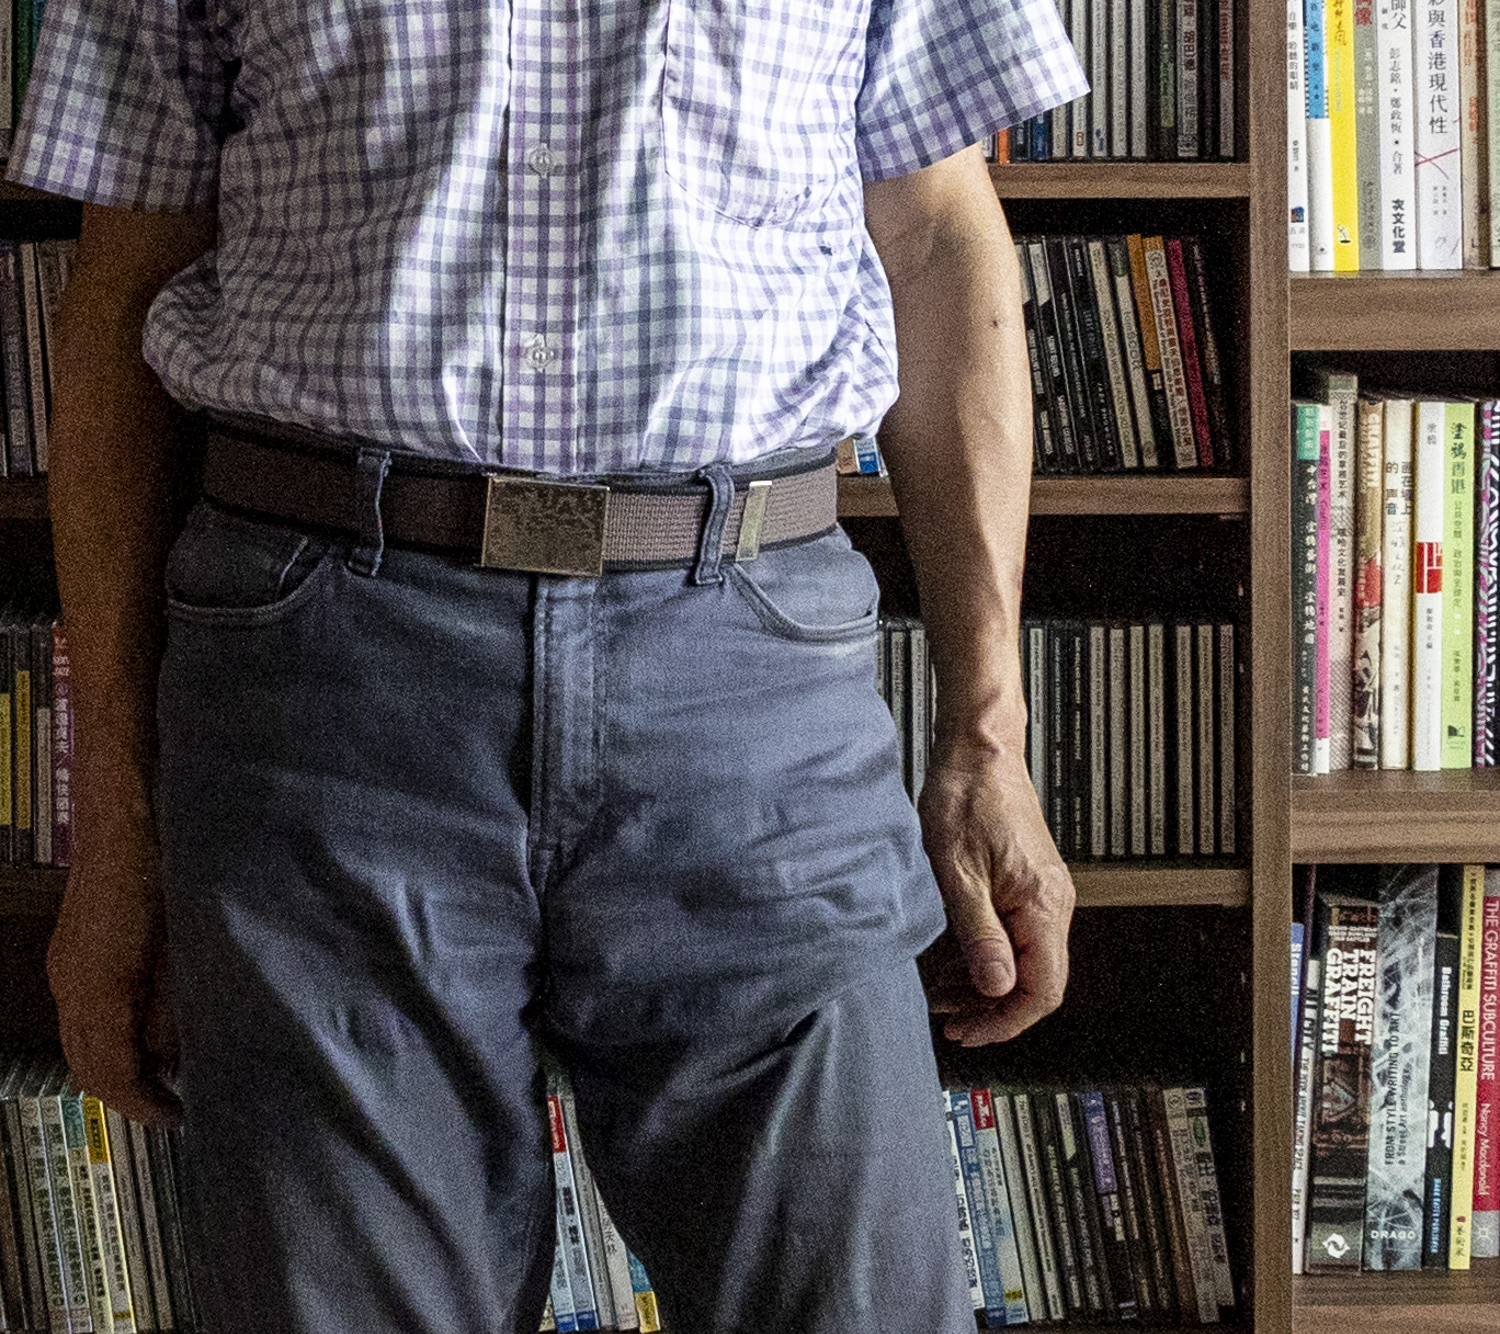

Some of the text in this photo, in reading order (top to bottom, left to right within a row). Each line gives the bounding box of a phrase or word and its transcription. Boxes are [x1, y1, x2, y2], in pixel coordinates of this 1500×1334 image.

[1323, 948, 1342, 1056] GRAFFITI
[1340, 949, 1359, 1022] TRAIN
[1355, 949, 1377, 1046] FREIGHT
[1438, 966, 1452, 1056] Bathroom Graffiti
[1476, 901, 1499, 1197] THE GRAFFITI SUBCULTURE Nancy Macdonald
[1370, 1229, 1416, 1241] DRAGO
